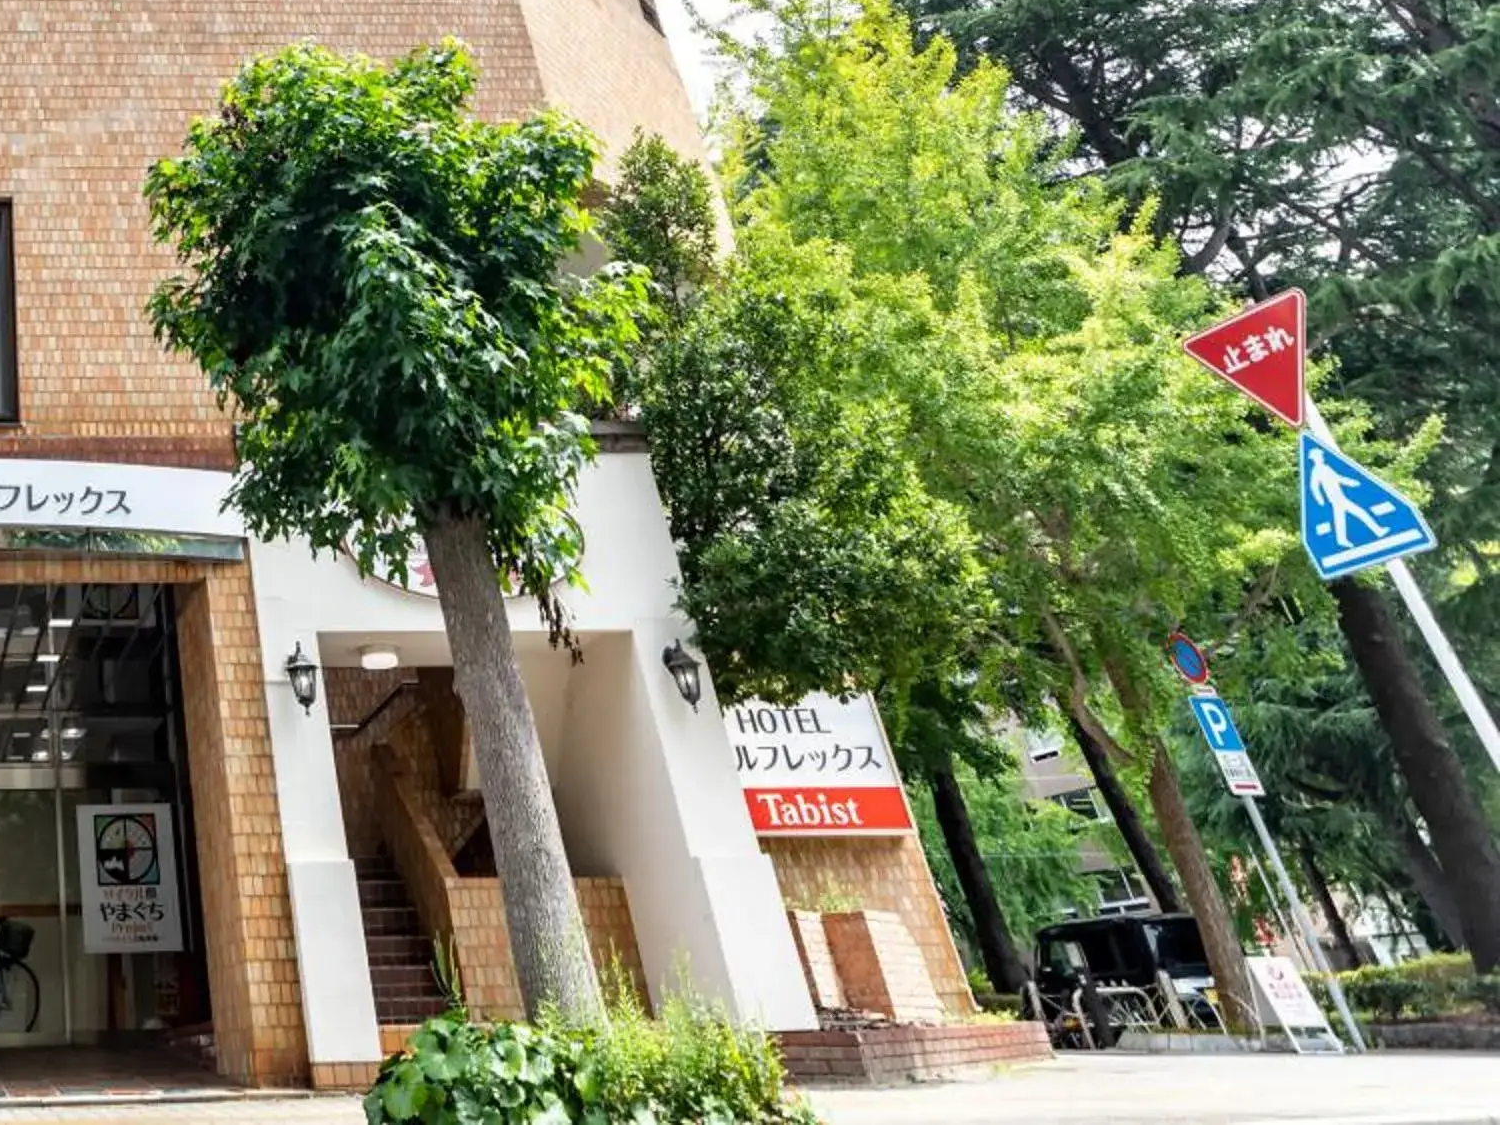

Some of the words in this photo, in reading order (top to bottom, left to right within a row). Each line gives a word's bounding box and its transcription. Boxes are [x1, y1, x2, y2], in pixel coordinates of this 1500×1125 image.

[1222, 325, 1296, 374] 止まれ
[735, 708, 833, 735] HOTEL
[1199, 701, 1228, 747] P
[756, 793, 863, 827] Tabist
[99, 901, 165, 922] やまぐち
